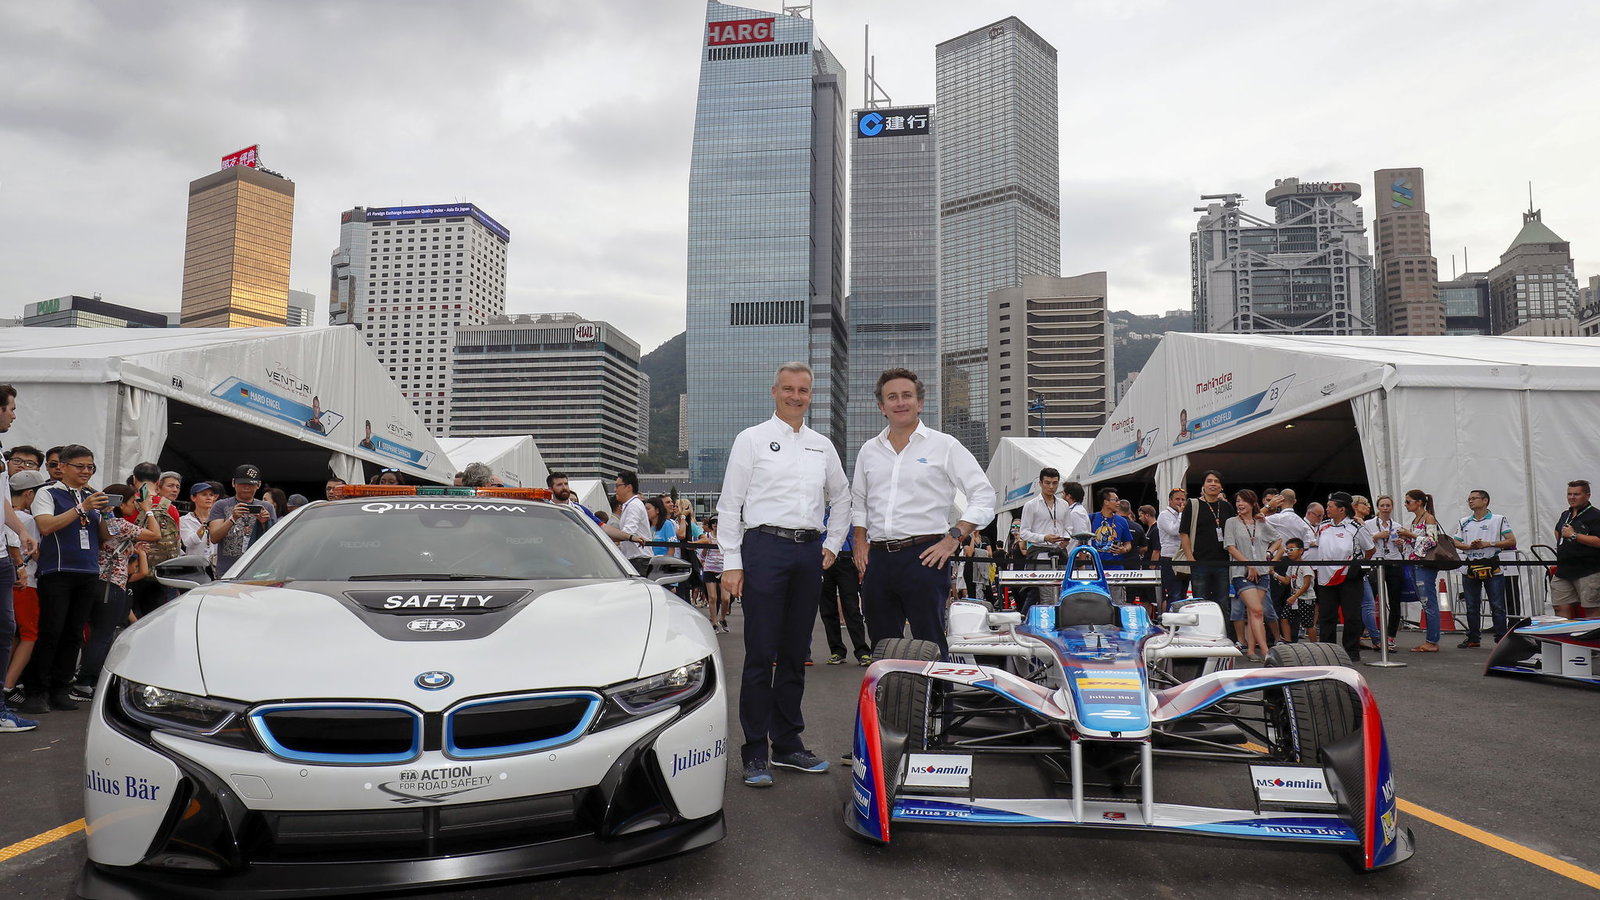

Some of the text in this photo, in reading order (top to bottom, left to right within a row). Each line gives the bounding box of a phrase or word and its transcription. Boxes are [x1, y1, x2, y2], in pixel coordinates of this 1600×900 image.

[885, 114, 928, 130] 建行
[1296, 184, 1327, 194] HSBC
[265, 367, 312, 394] VENTURI
[1196, 372, 1233, 395] Mahindra
[1270, 387, 1279, 400] 23
[266, 397, 281, 411] ENGEL
[327, 415, 331, 426] 5
[1111, 416, 1135, 432] Mahindra
[361, 502, 526, 514] QUALCOMM
[383, 594, 493, 609] SAFETY
[409, 619, 462, 630] FIA
[931, 668, 979, 676] 28
[672, 748, 712, 778] Julius
[421, 765, 472, 781] ACTION
[911, 765, 969, 775] MS amlin
[125, 775, 160, 800] Bär
[417, 780, 448, 791] ROAD
[451, 775, 492, 789] SAFETY
[1256, 778, 1322, 789] MS amlin
[900, 808, 940, 817] Julius
[1265, 826, 1347, 836] Julius Bär
